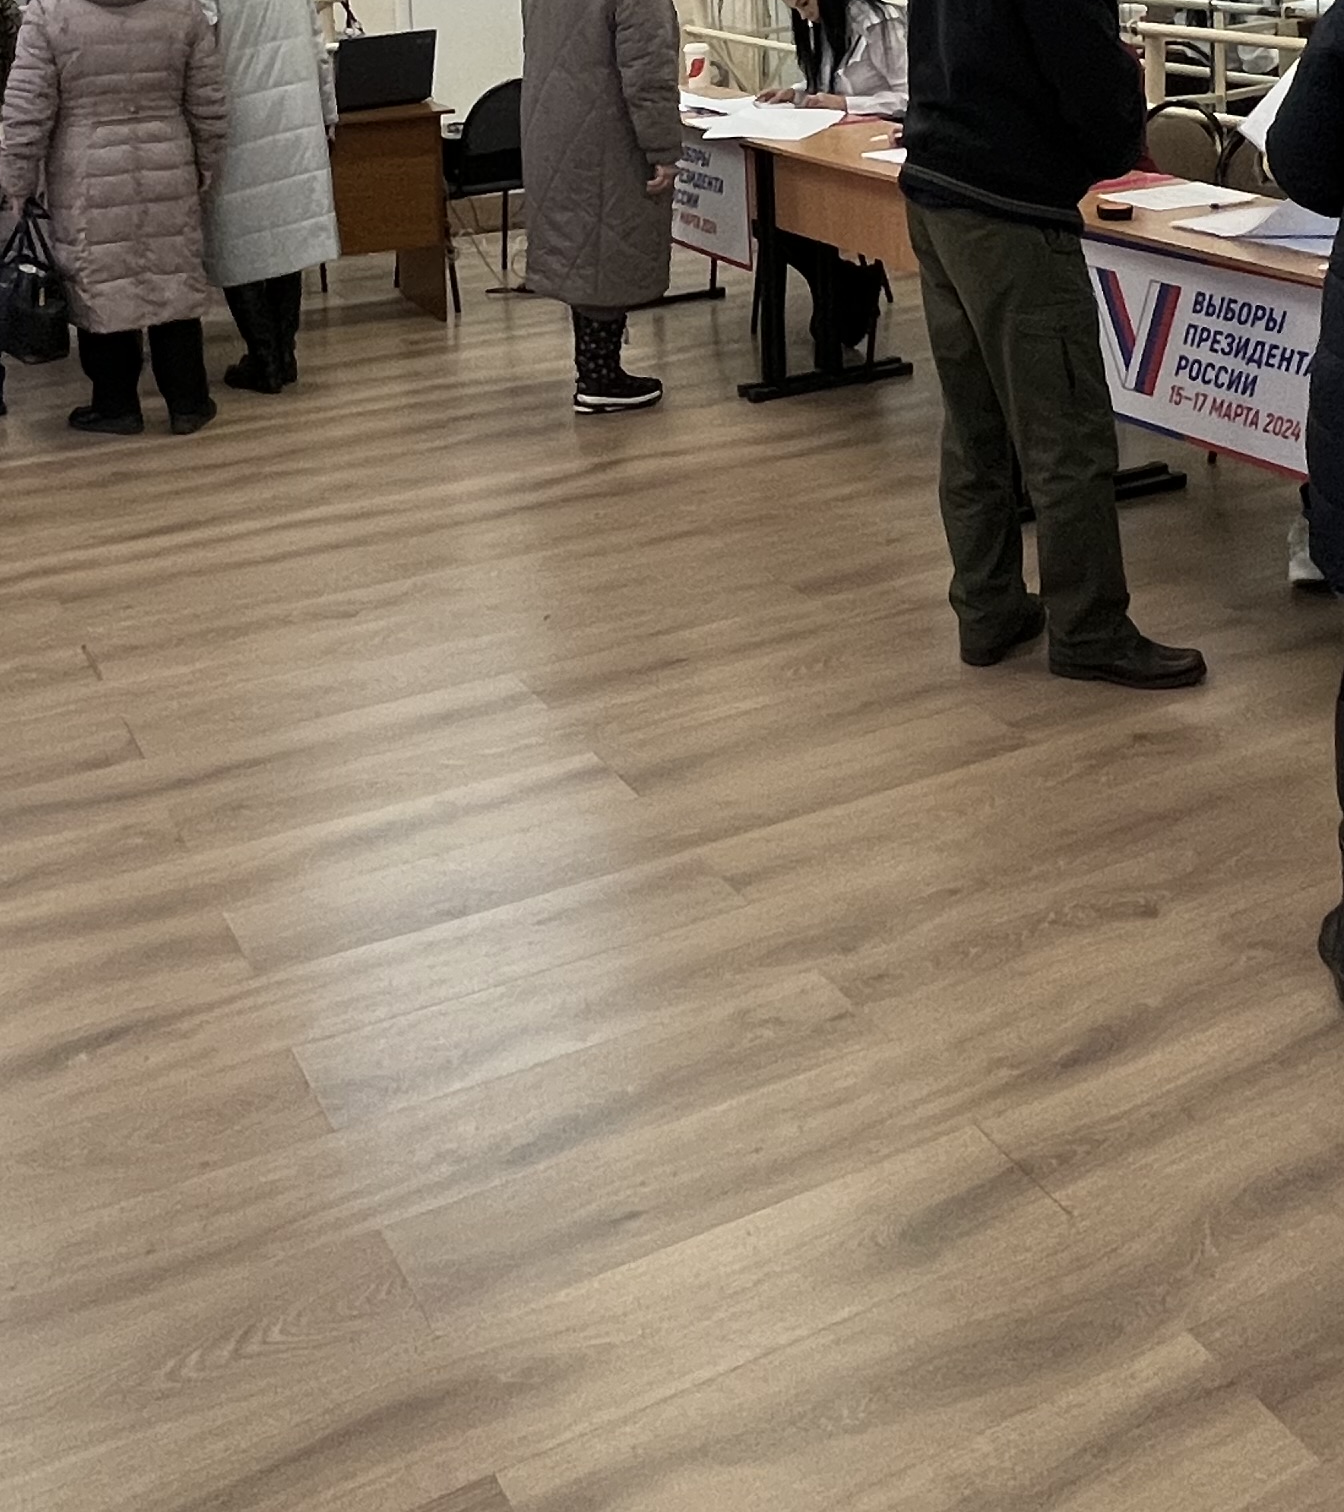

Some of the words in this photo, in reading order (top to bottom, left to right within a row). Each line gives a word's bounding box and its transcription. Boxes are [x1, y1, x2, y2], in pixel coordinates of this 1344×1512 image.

[1191, 290, 1288, 334] ВЫБОРЫ
[1174, 354, 1258, 398] РОССИИ
[1208, 396, 1261, 431] МАРТА
[1262, 412, 1302, 443] 2024
